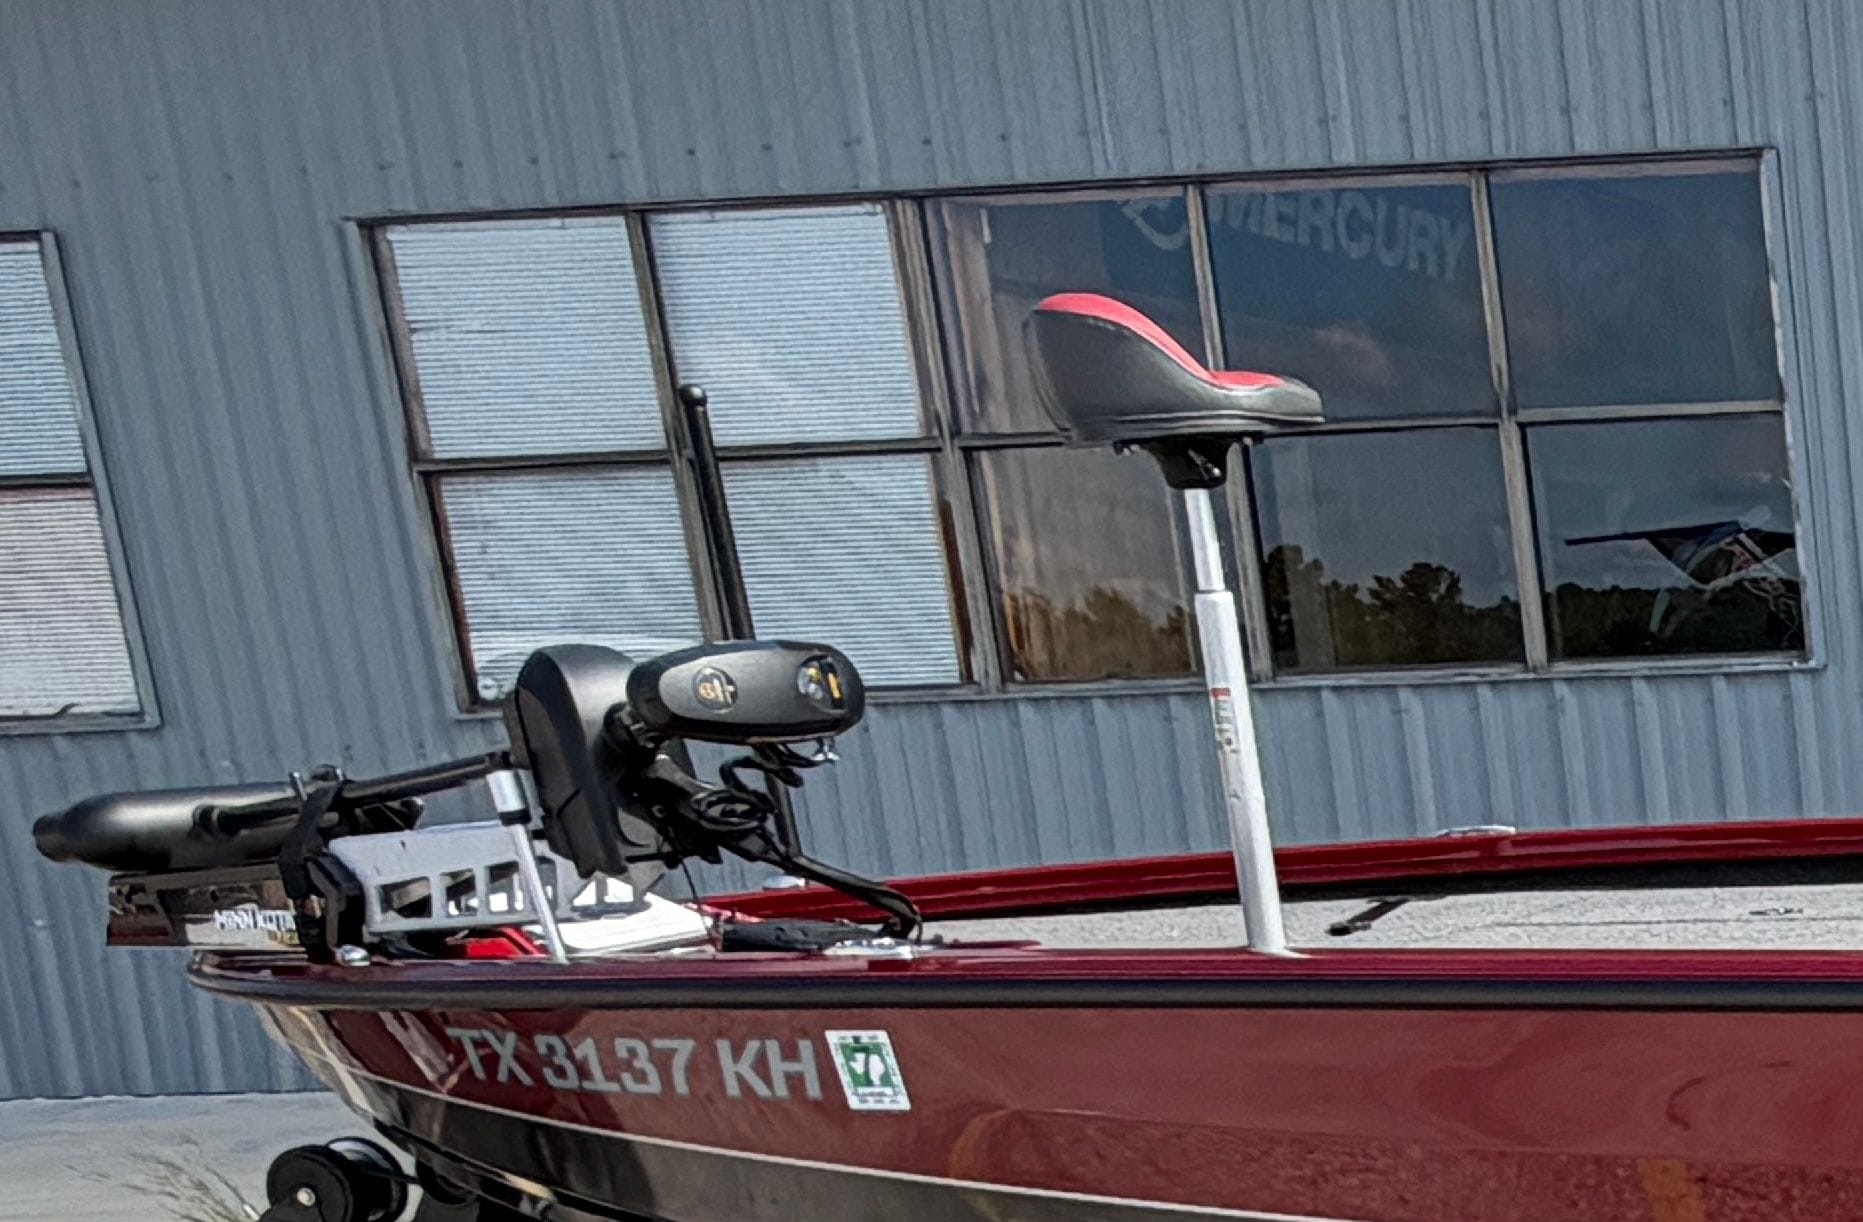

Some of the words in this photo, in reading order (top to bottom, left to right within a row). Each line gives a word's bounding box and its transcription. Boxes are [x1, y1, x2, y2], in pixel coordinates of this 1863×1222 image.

[446, 1027, 535, 1088] TX
[534, 1034, 696, 1096] 3137
[716, 1038, 824, 1100] KH
